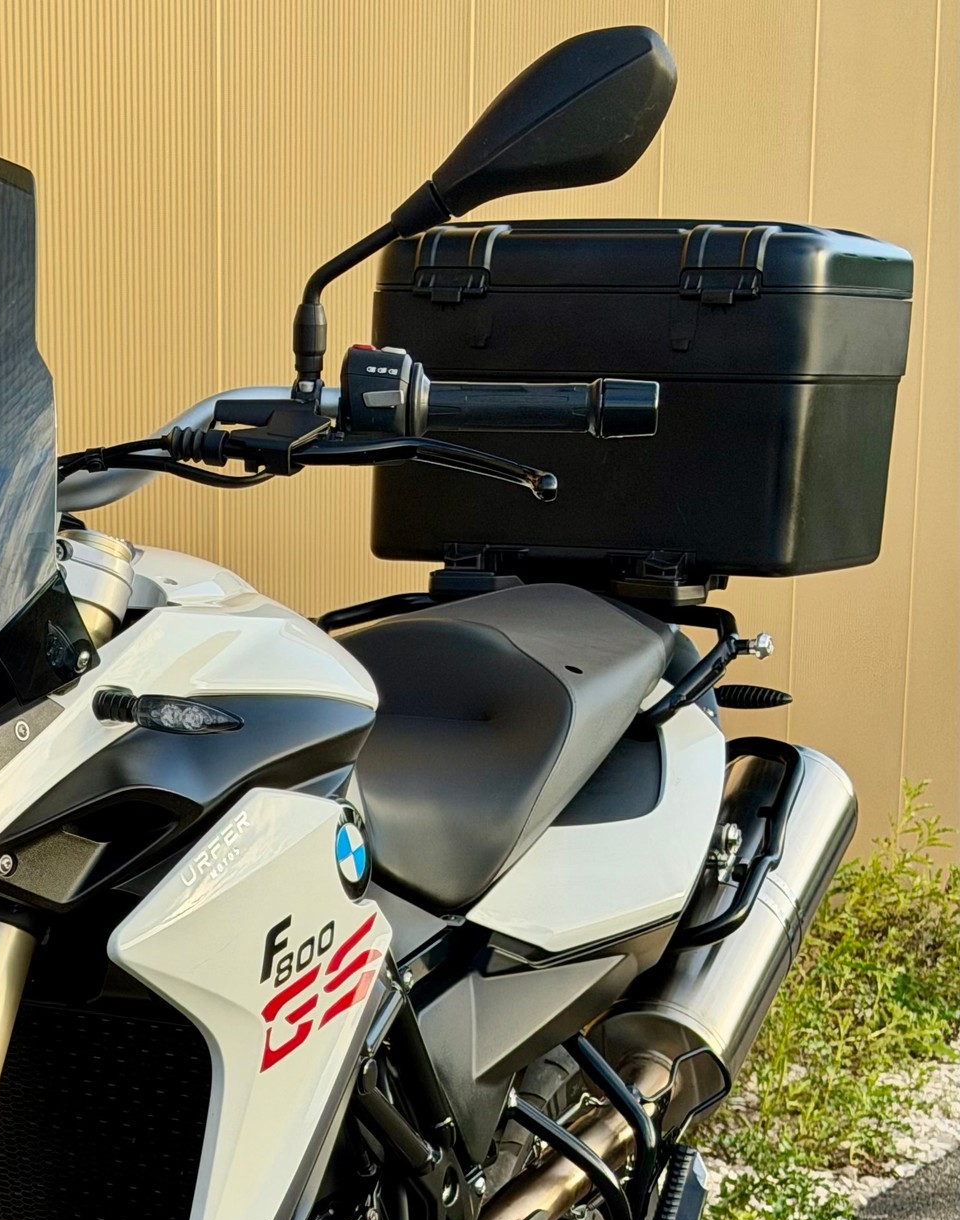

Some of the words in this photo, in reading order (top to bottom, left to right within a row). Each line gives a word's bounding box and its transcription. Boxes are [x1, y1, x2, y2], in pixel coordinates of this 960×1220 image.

[179, 810, 251, 887] URFER
[259, 914, 292, 984] F
[273, 920, 335, 988] 800
[259, 911, 383, 1073] GS
